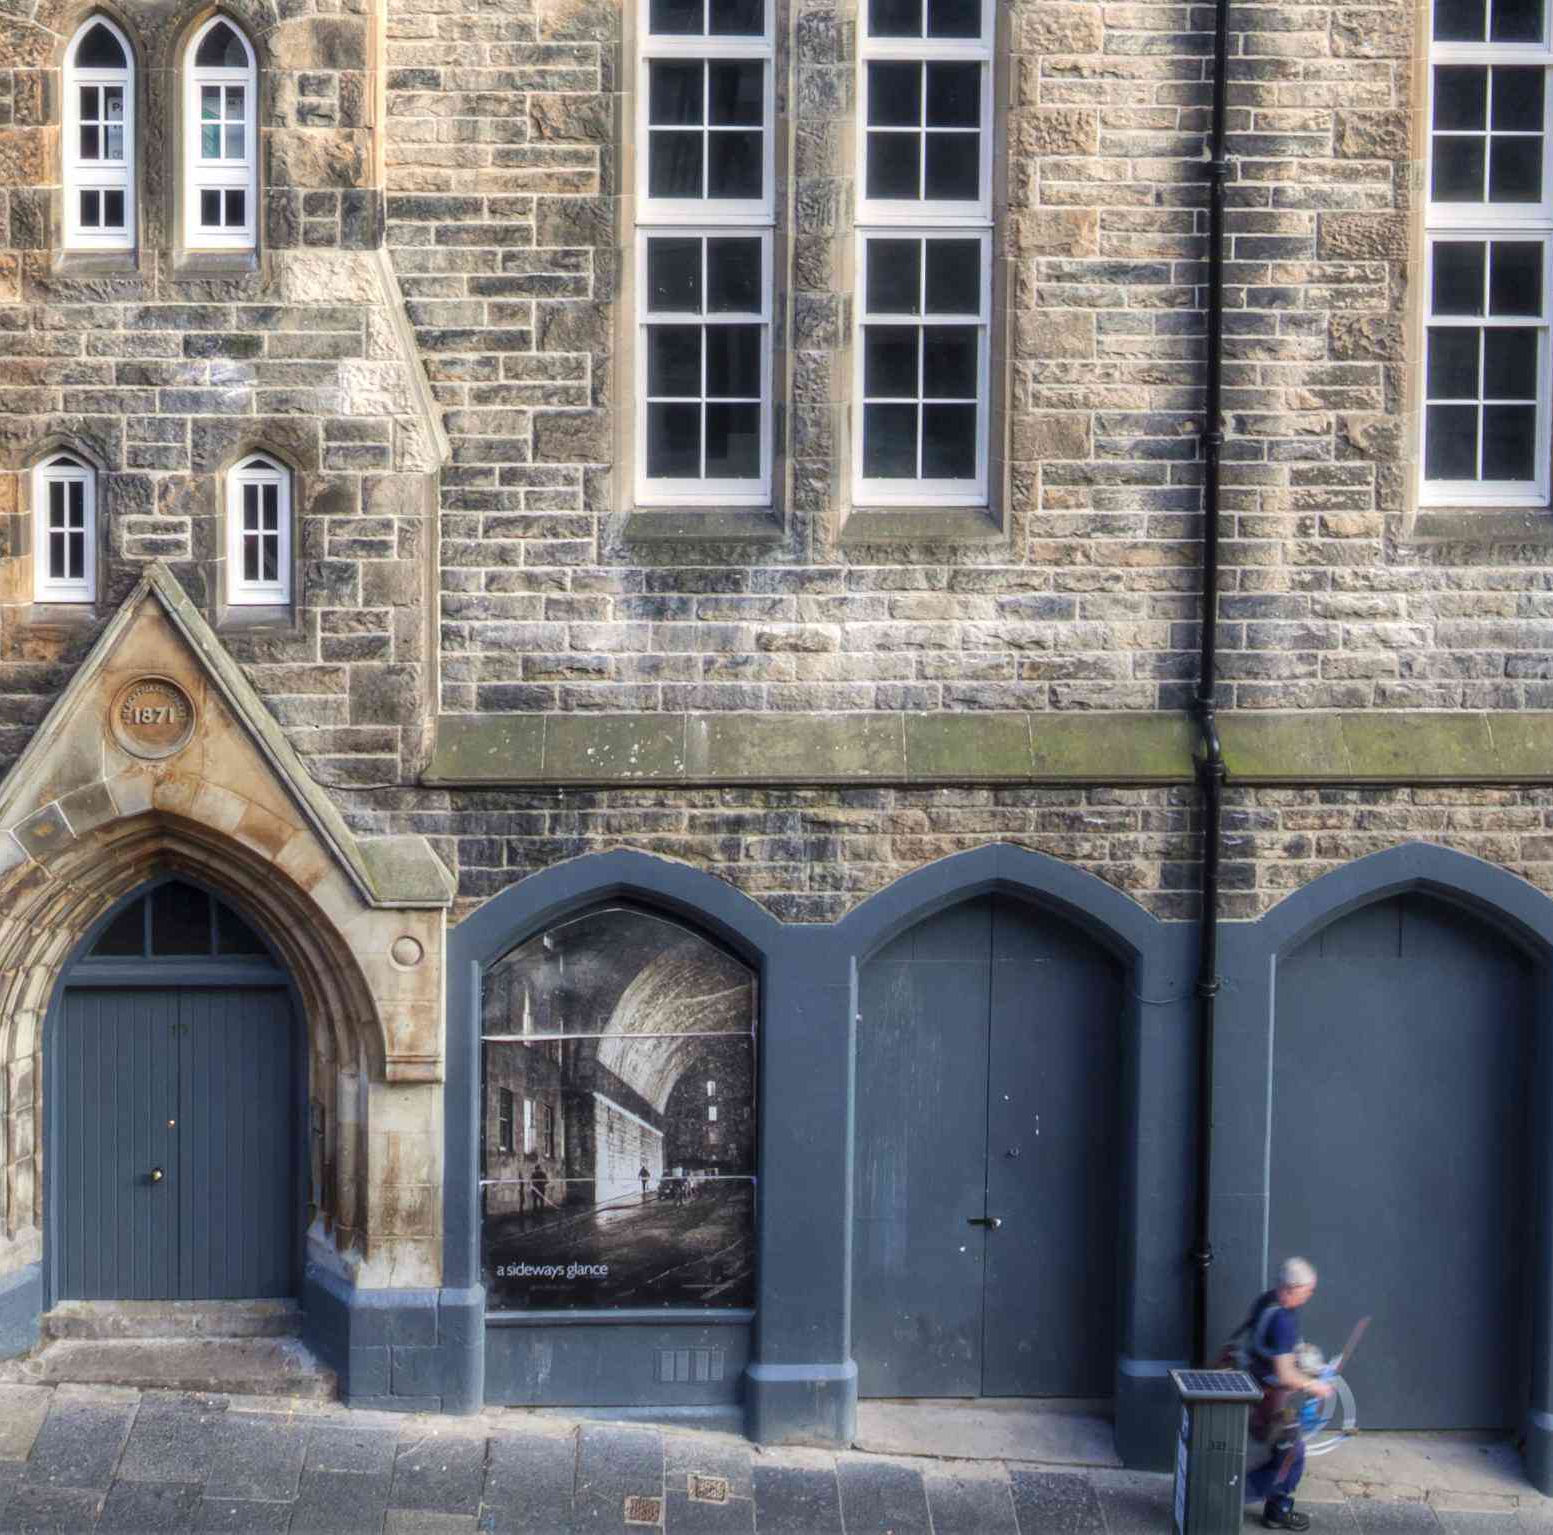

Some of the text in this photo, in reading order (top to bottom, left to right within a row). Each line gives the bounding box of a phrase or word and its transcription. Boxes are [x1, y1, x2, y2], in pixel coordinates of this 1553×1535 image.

[134, 706, 175, 724] 1871
[496, 1261, 608, 1280] a sideways glance
